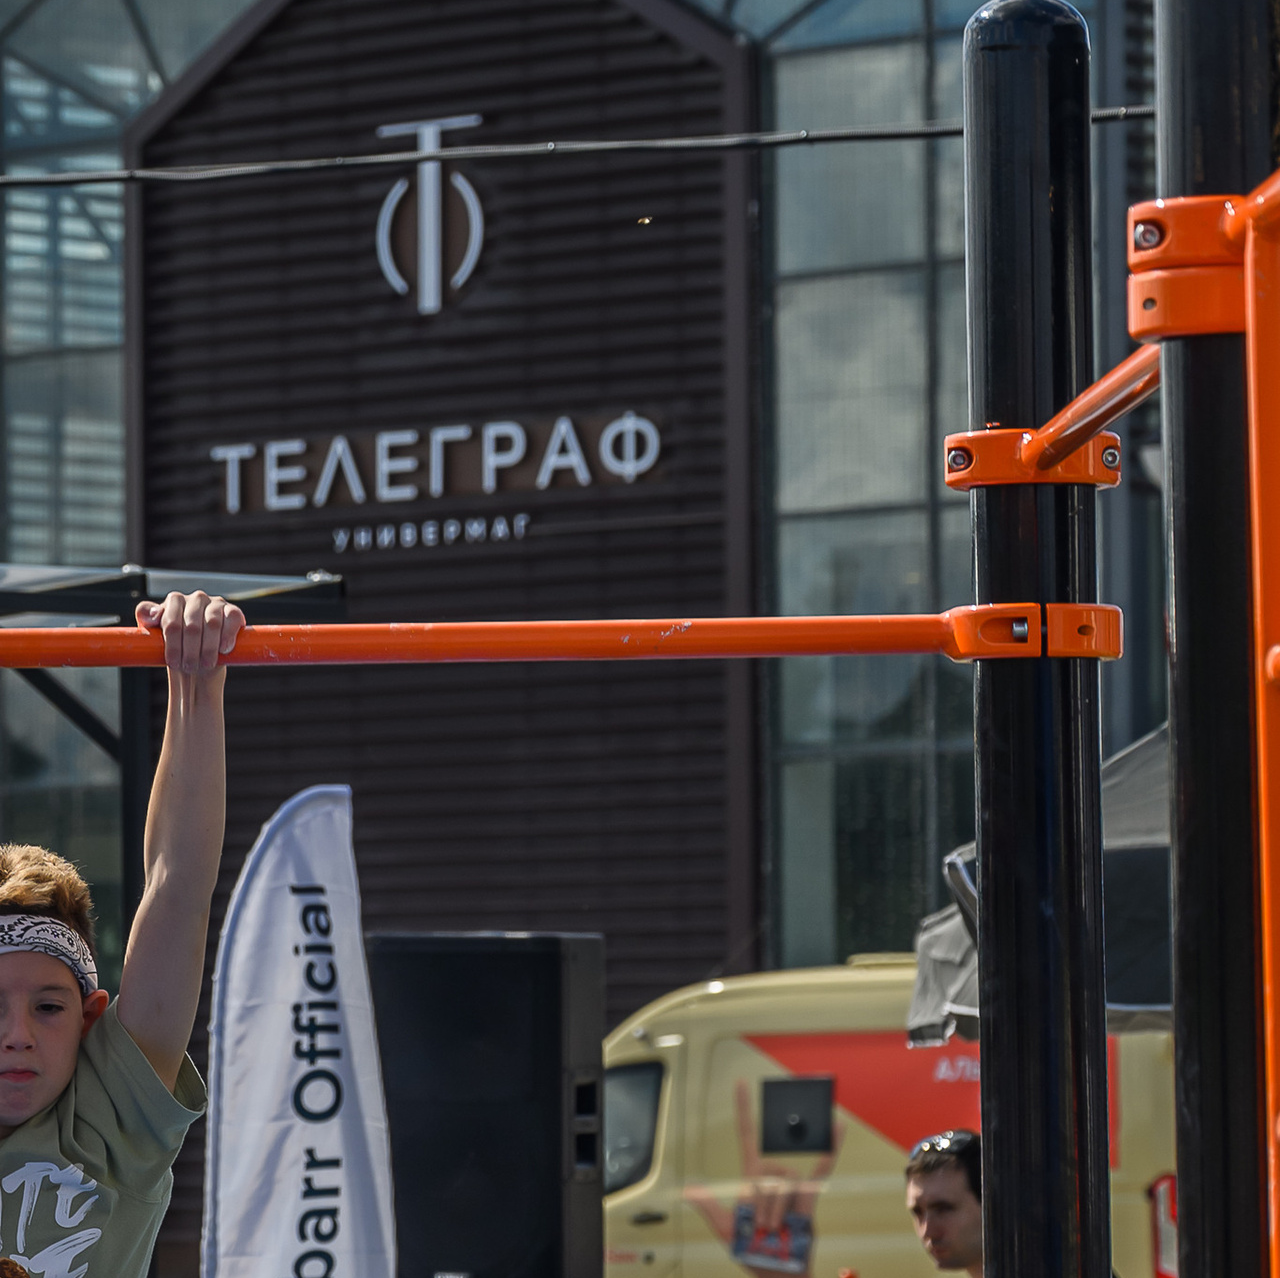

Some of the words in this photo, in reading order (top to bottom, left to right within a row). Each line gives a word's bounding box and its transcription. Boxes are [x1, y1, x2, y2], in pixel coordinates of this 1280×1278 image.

[210, 410, 661, 514] ТЕЛЕГРАФ
[332, 513, 530, 554] УНИВЕРМАГ
[291, 884, 344, 1124] Official
